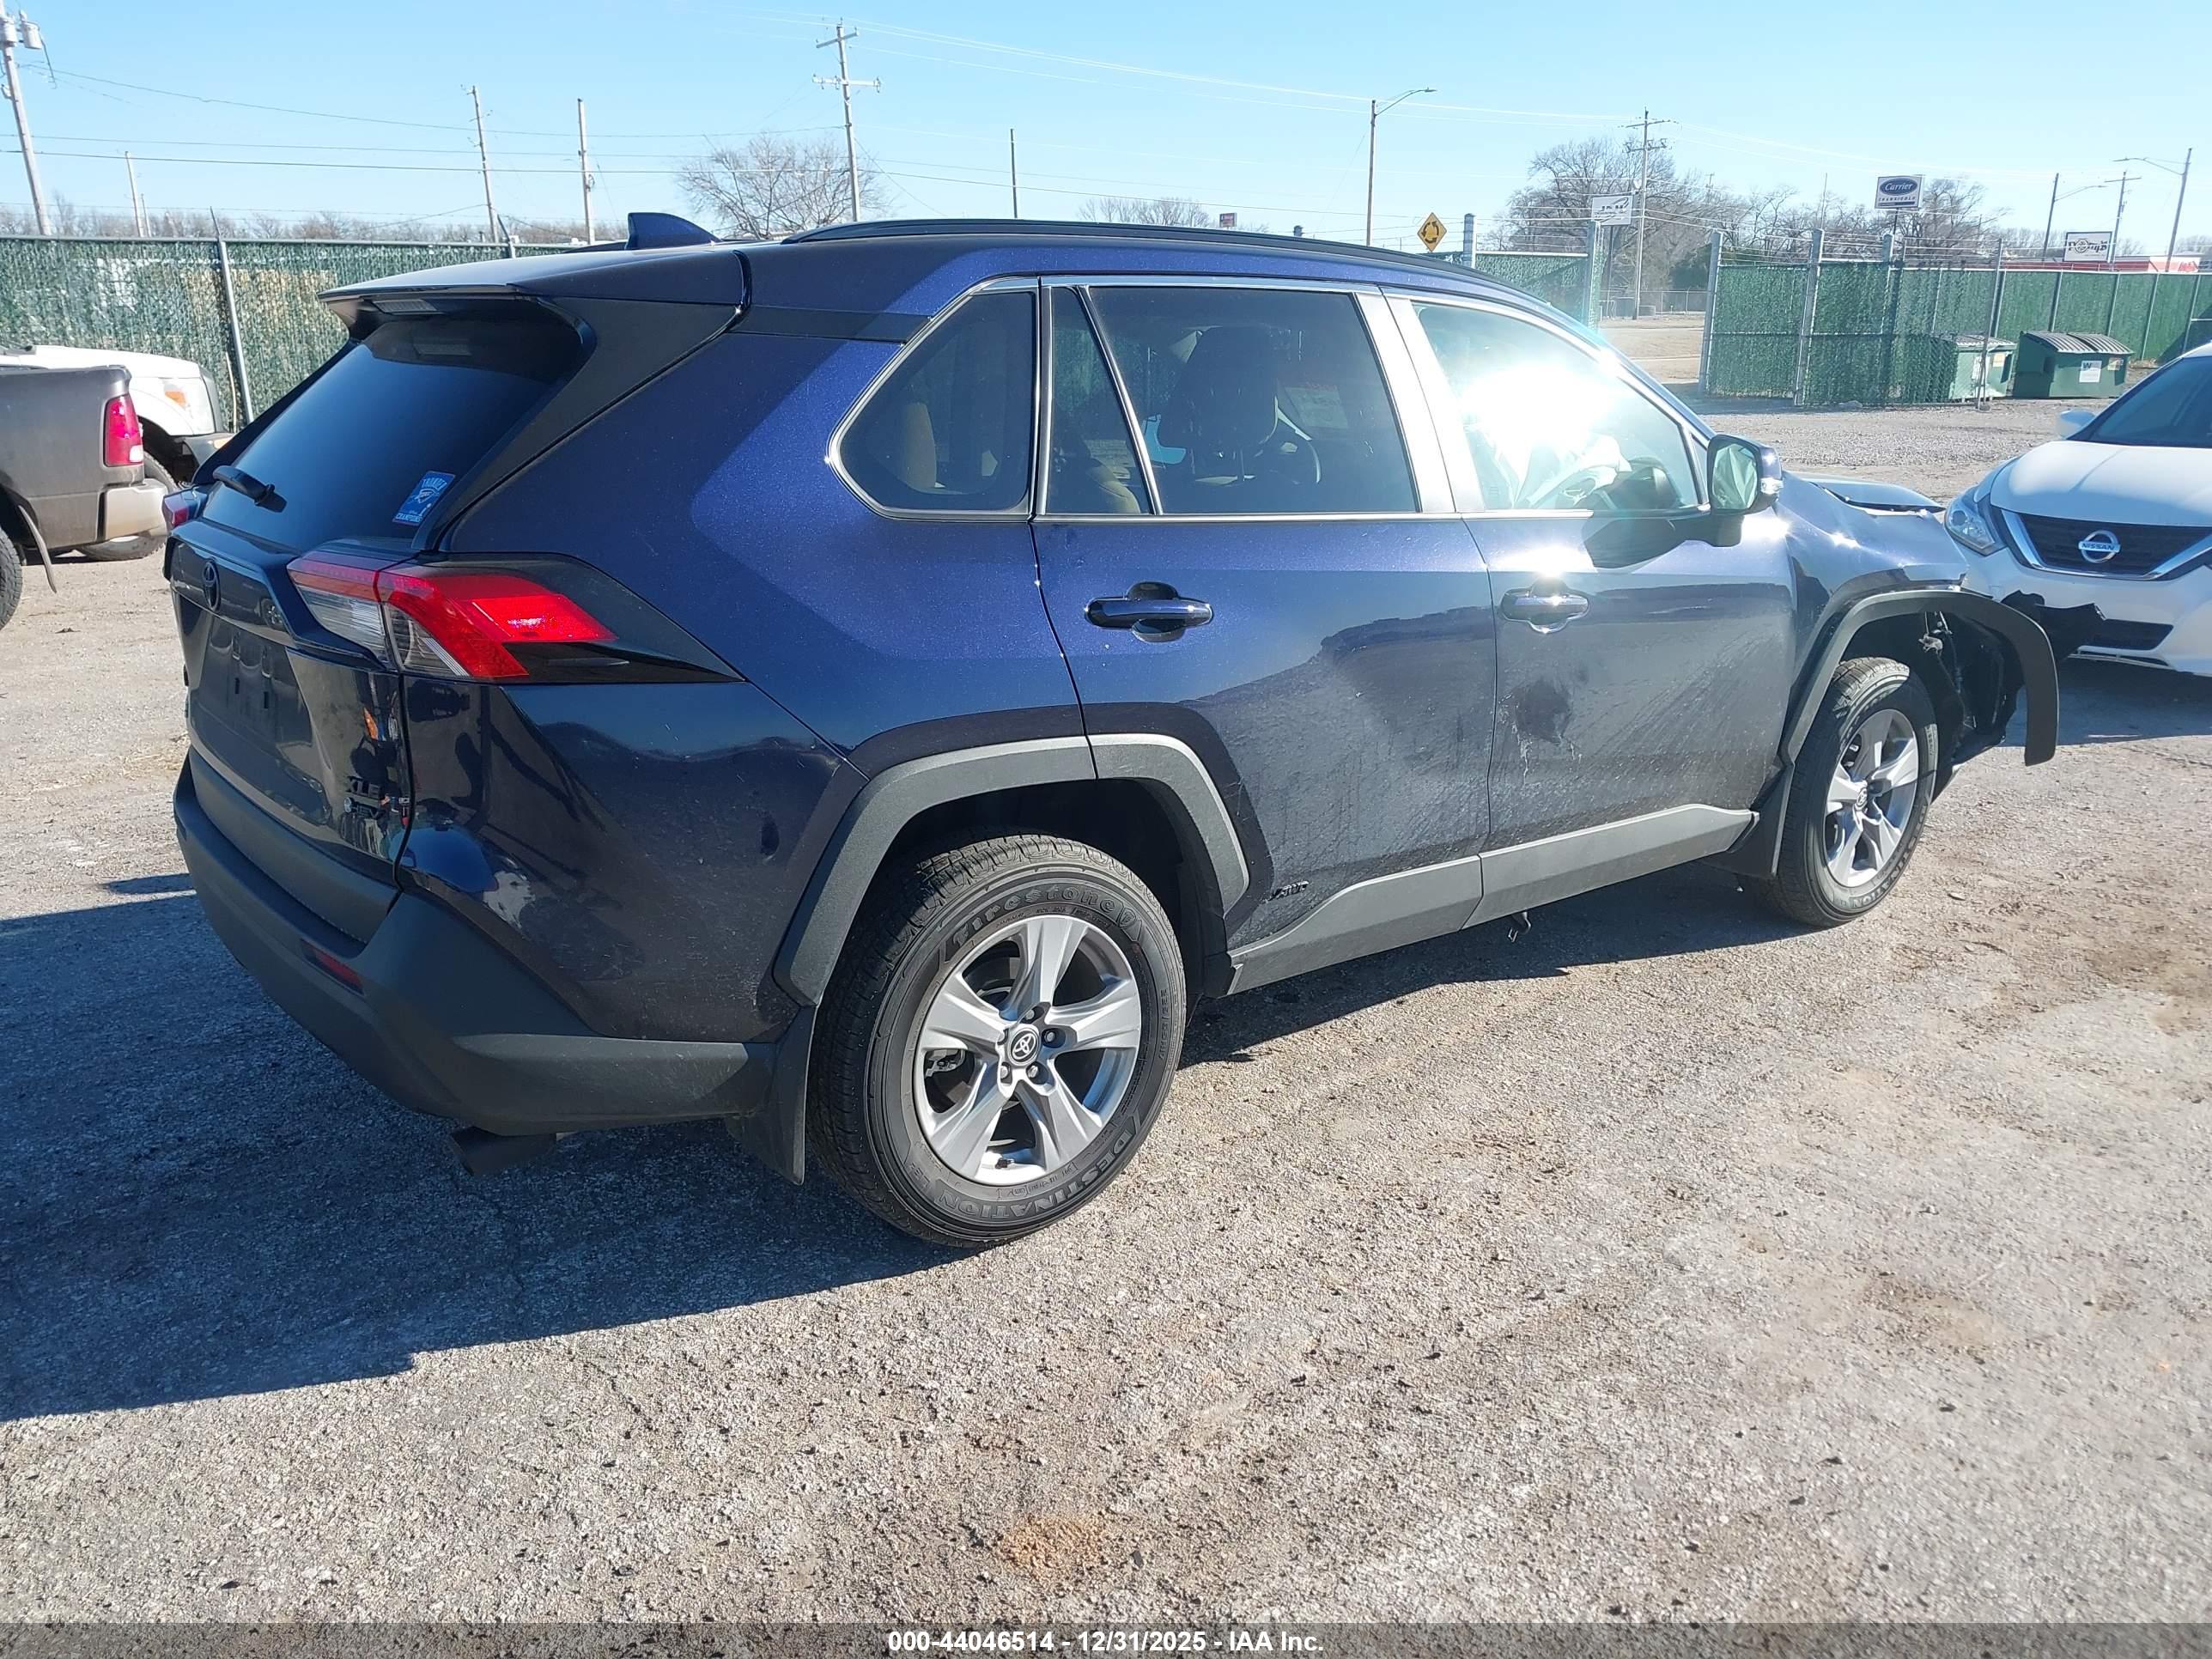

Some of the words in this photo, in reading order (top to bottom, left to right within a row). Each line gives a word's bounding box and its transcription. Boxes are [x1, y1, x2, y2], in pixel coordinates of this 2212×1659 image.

[1886, 182, 1913, 191] Carrier
[2081, 542, 2115, 550] NISSAN
[345, 776, 380, 798] XLE
[953, 884, 1116, 945] Firestone
[936, 1129, 1134, 1218] DESTINATION
